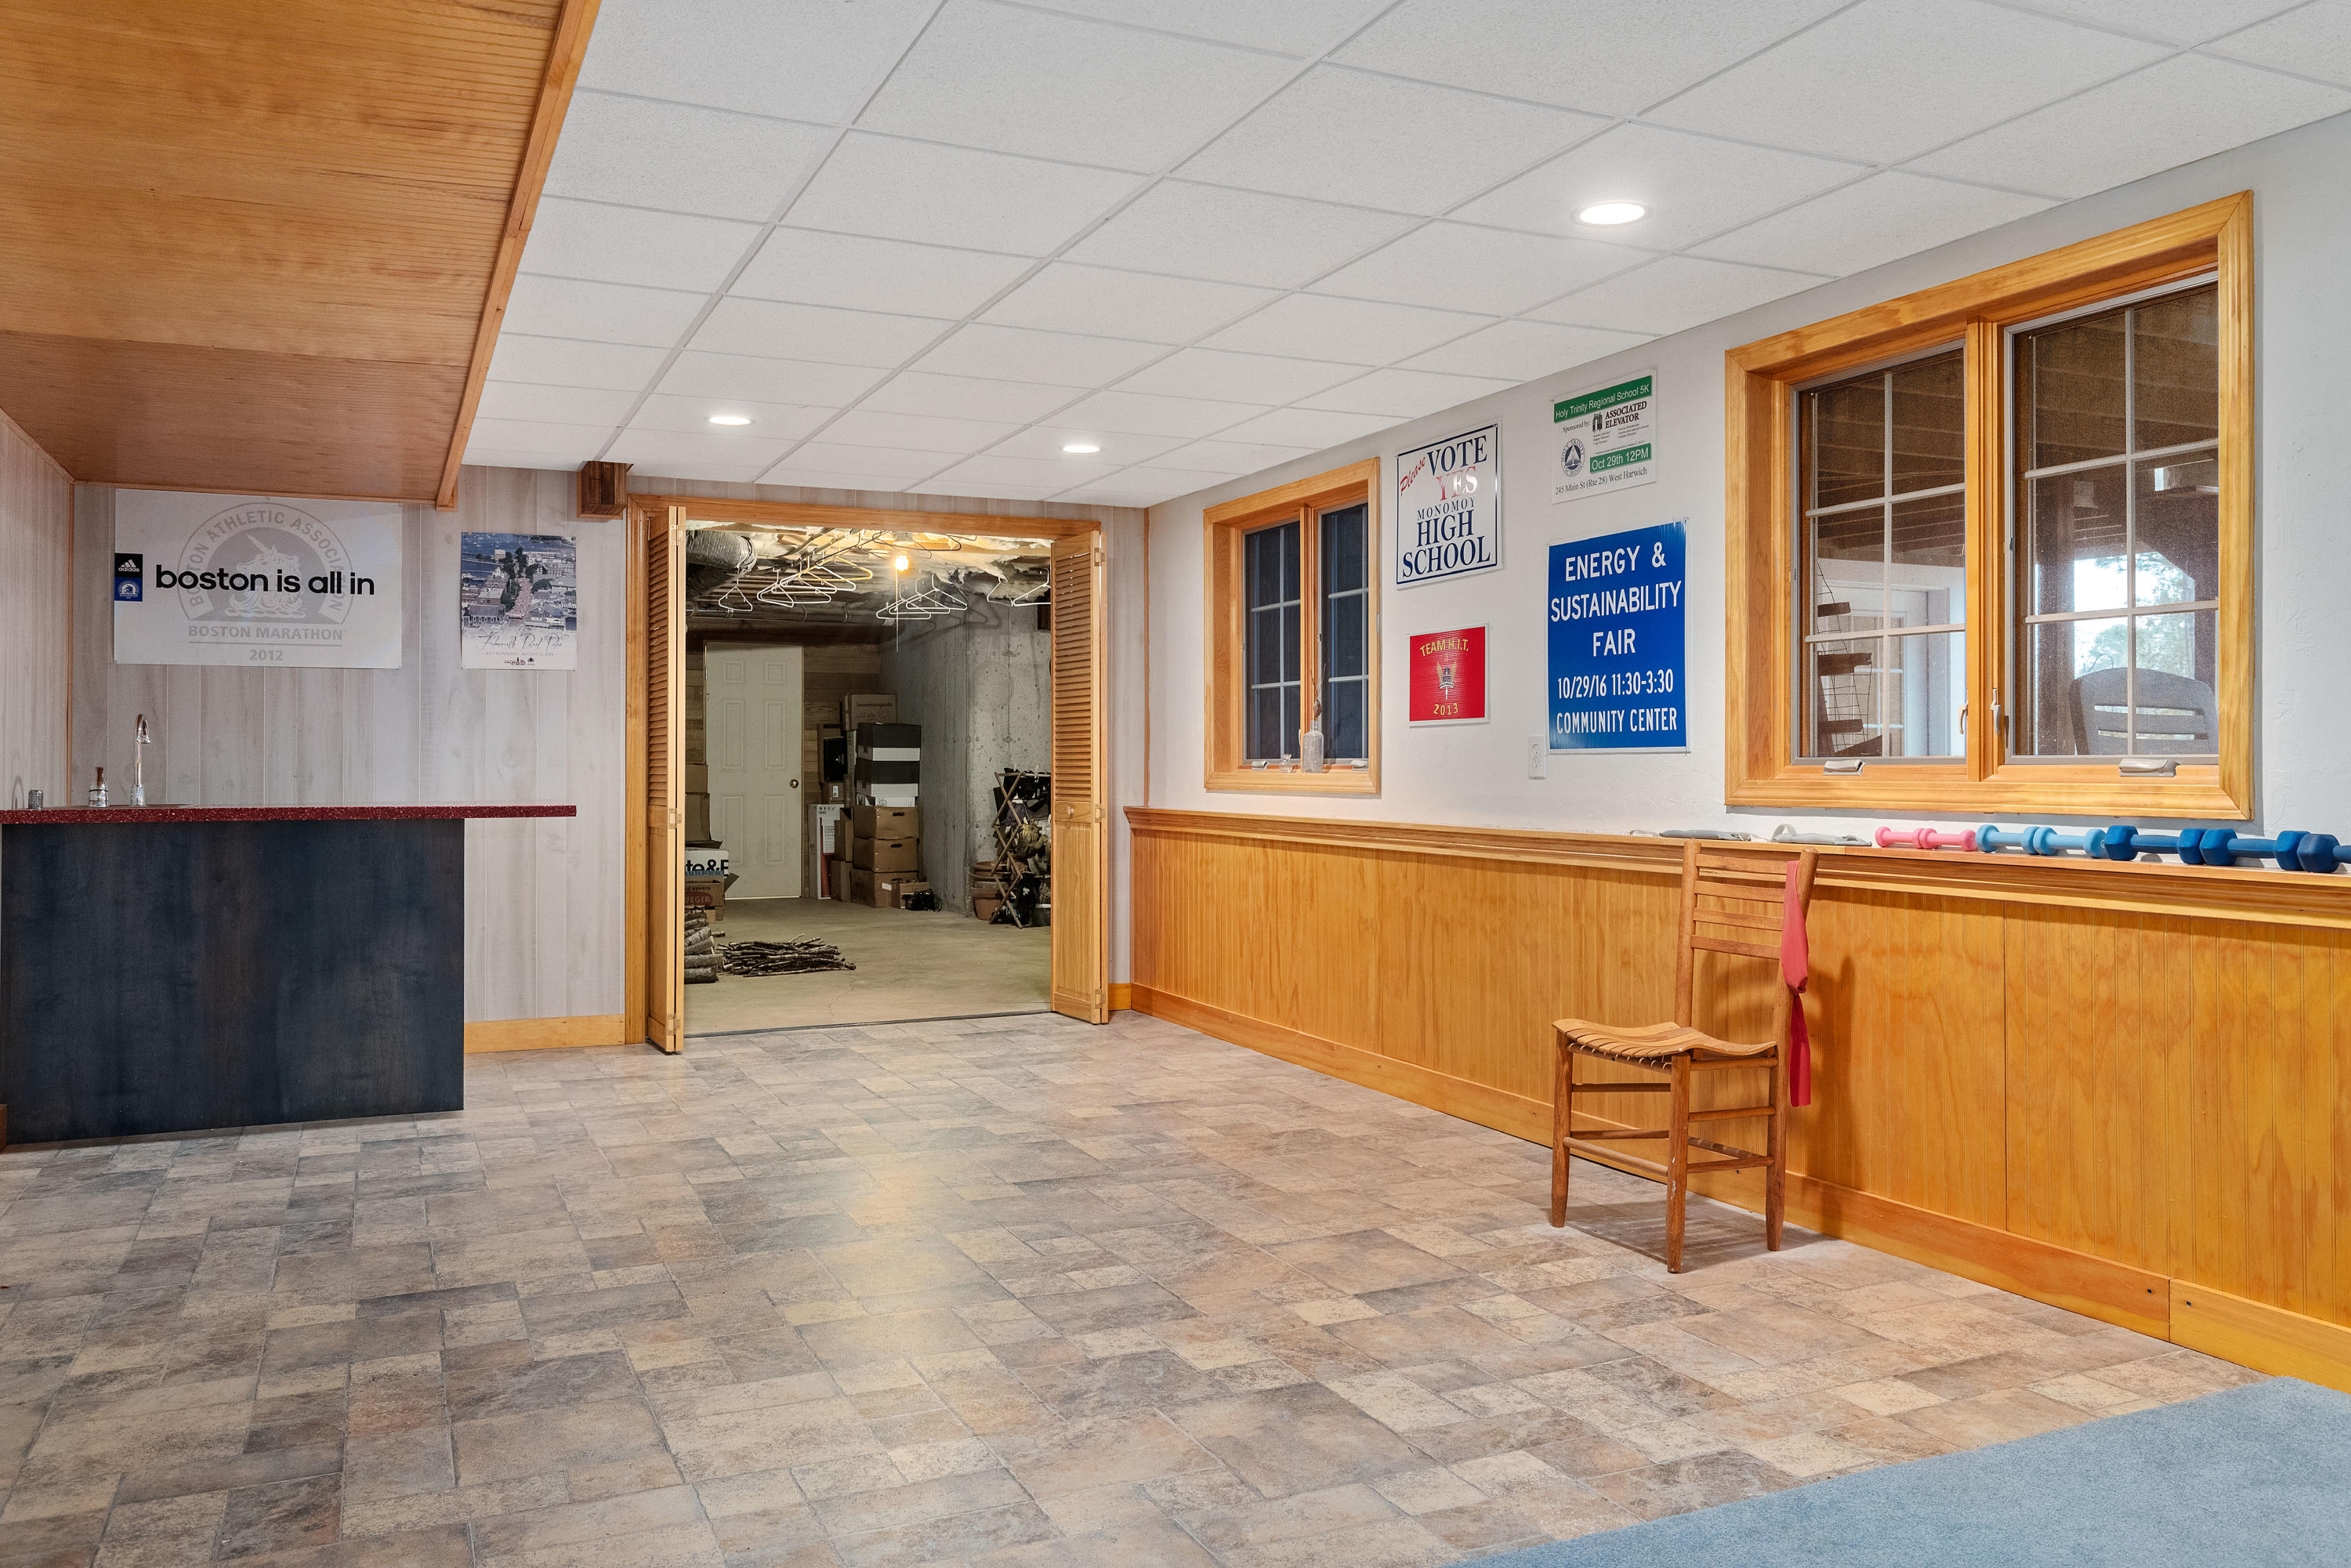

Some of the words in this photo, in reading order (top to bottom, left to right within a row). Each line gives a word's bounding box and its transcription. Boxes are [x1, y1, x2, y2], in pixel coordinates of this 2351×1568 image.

[1556, 409, 1569, 418] Holy
[1570, 403, 1588, 415] Trinity
[1588, 394, 1616, 409] Regional
[1617, 389, 1639, 401] School
[1639, 384, 1650, 394] 5K
[1605, 400, 1647, 420] ASSOCIATED
[1563, 423, 1584, 433] Sponsored
[1605, 413, 1639, 429] ELEVATOR
[1427, 436, 1487, 476] VOTE
[1592, 459, 1605, 471] Oct
[1607, 454, 1624, 467] 29th
[1626, 450, 1649, 463] 12PM
[1400, 457, 1426, 497] Please
[1436, 466, 1478, 502] YES
[1556, 486, 1565, 495] 245
[1566, 481, 1579, 493] Main
[1580, 480, 1586, 490] St
[1586, 476, 1597, 490] (Rte
[1598, 475, 1607, 487] 28)
[1609, 472, 1622, 482] West
[1624, 466, 1647, 479] Harwich
[1417, 497, 1475, 520] MONOMOY
[205, 510, 285, 543] ATHLETIC
[1417, 509, 1474, 547] HIGH
[1403, 536, 1491, 578] SCHOOL
[1565, 545, 1640, 581] ENERGY
[1651, 541, 1666, 568] &
[156, 564, 269, 592] boston
[277, 569, 301, 593] is
[308, 571, 342, 594] all
[350, 572, 375, 595] in
[1550, 581, 1682, 622] SUSTAINABILITY
[188, 625, 251, 639] BOSTON
[255, 628, 342, 640] MARATHON
[1592, 628, 1636, 657] FAIR
[249, 650, 284, 661] 2012
[1419, 641, 1446, 657] TEAM
[1448, 639, 1469, 652] H.I.T.
[1558, 673, 1607, 699] 10/29/16
[1611, 668, 1674, 696] 11:30-3:30
[1433, 703, 1458, 715] 2013
[1556, 709, 1625, 733] COMMUNITY
[1630, 707, 1678, 732] CENTER
